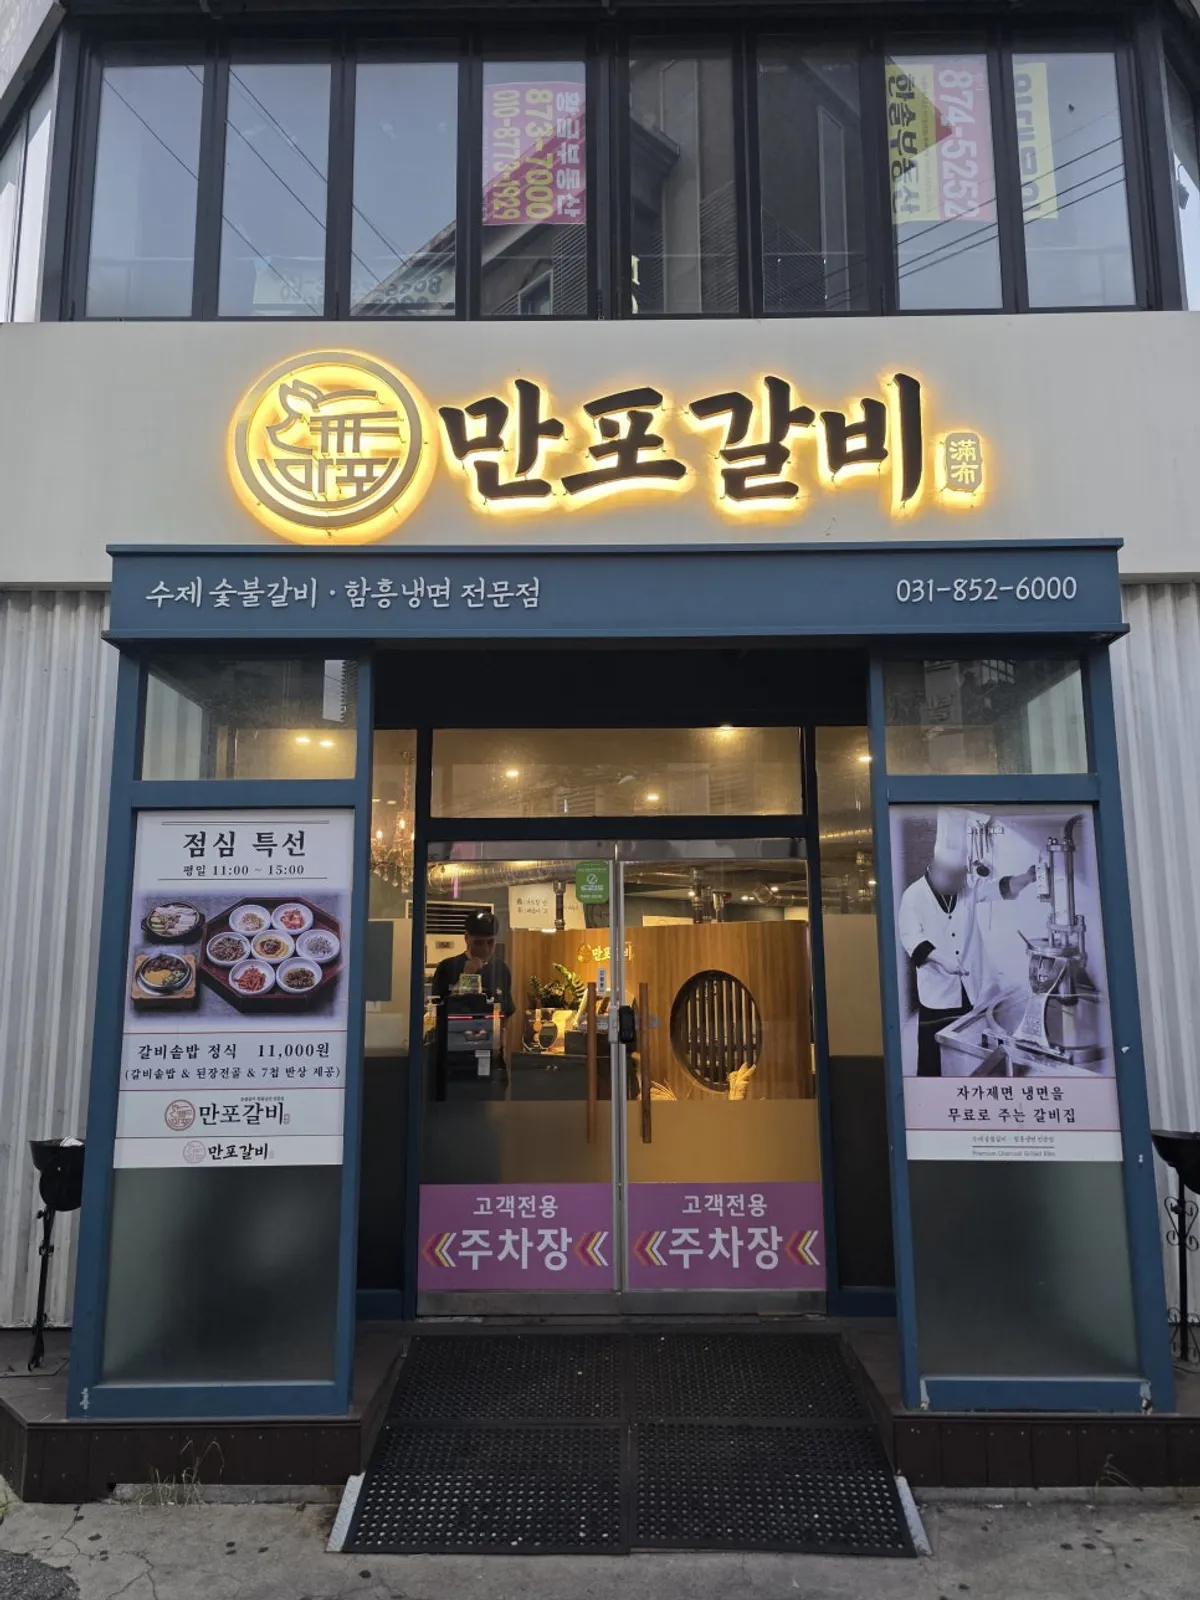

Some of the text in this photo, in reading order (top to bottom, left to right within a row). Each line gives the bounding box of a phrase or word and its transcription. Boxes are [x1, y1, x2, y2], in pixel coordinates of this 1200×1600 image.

[525, 89, 553, 218] 873-7000
[938, 69, 979, 218] 874-5252
[438, 373, 924, 502] 만포갈비
[344, 577, 450, 608] 함흥냉면
[460, 577, 540, 608] 전문점
[896, 576, 1077, 602] 031-852-6000
[183, 830, 306, 858] 점심 특선
[183, 864, 206, 877] 평일
[212, 865, 249, 876] 11:00
[267, 864, 305, 876] 15:00
[137, 1042, 331, 1060] 갈비솥밥 정식 11,000원
[285, 1066, 308, 1079] 반상
[1022, 1085, 1064, 1101] 냉면을
[199, 1102, 283, 1126] 만포갈비
[948, 1107, 1075, 1124] 무료로 주는 갈비집
[208, 1143, 268, 1161] 만포갈비
[473, 1194, 558, 1218] 고객전용
[682, 1193, 768, 1217] 고객전용
[458, 1226, 572, 1271] 주차장
[668, 1226, 783, 1270] 주차장
